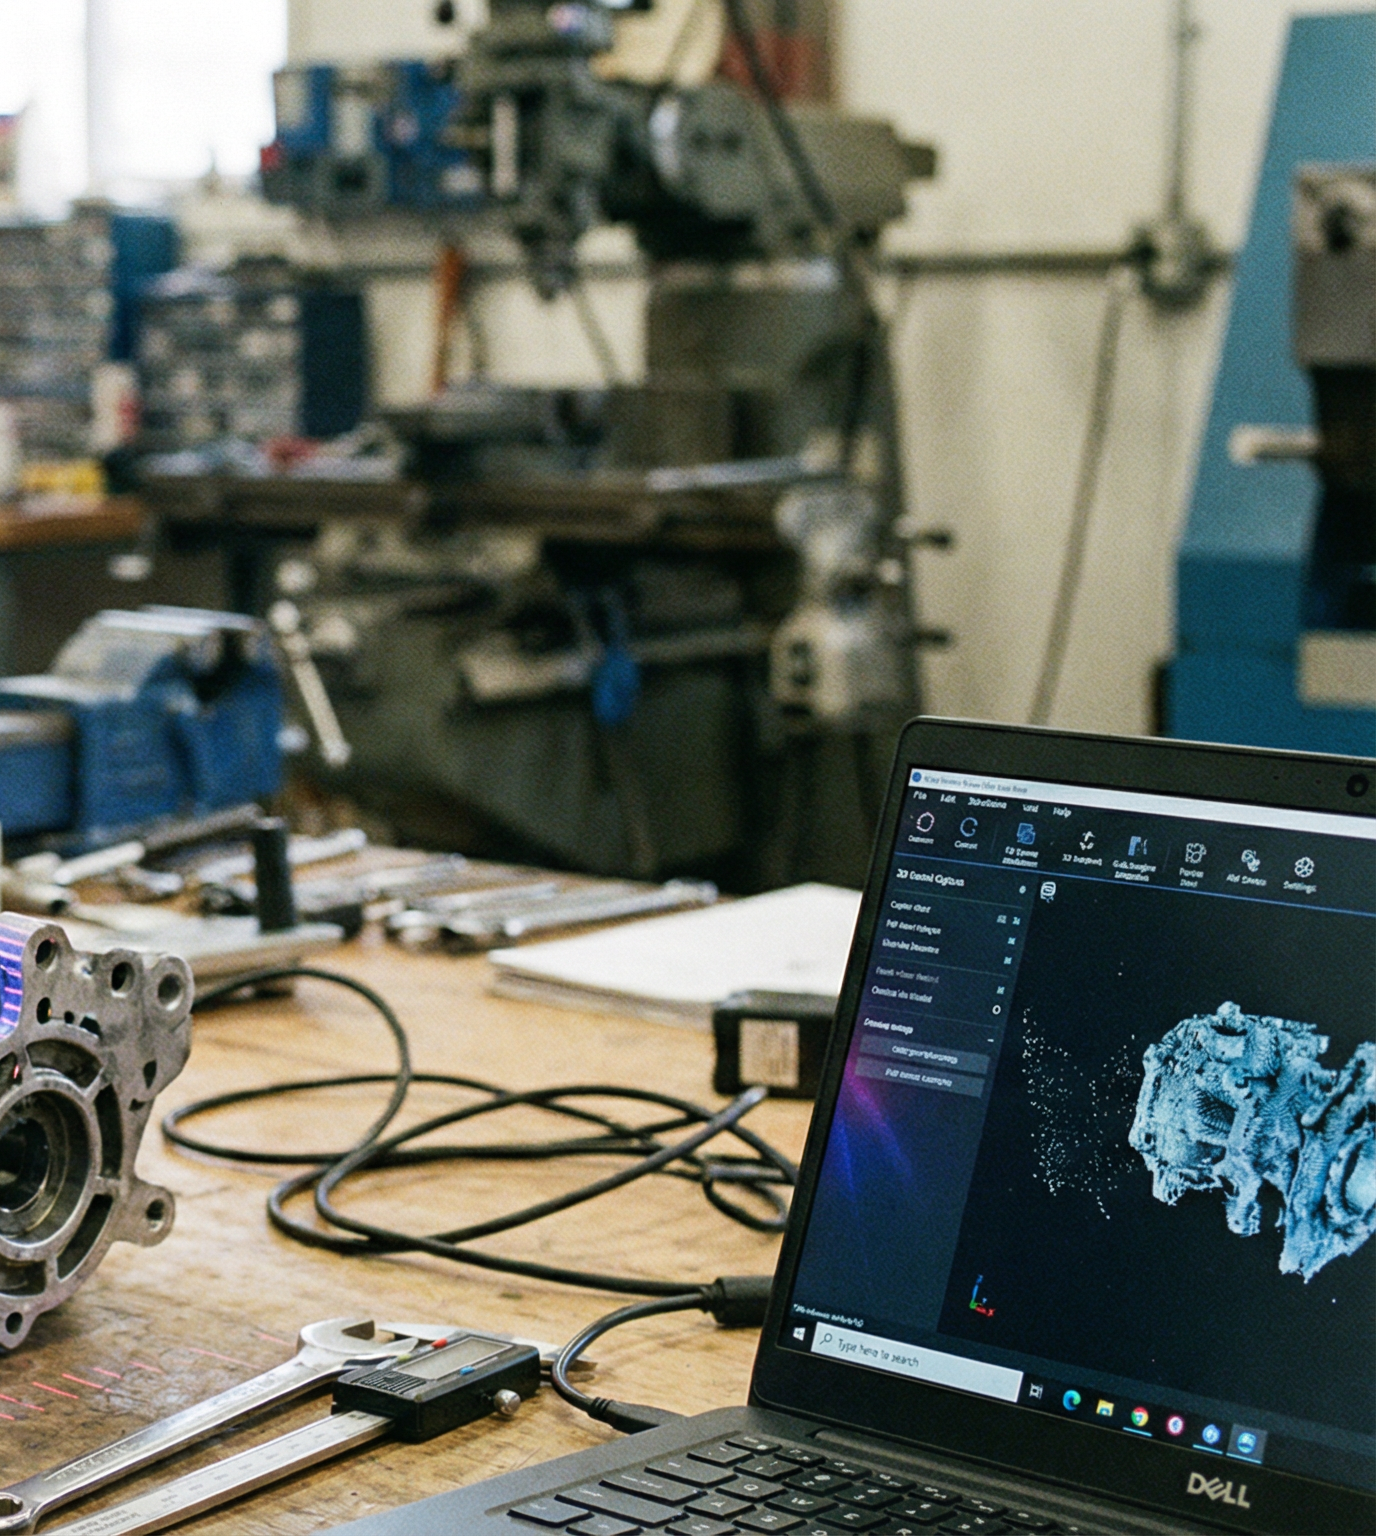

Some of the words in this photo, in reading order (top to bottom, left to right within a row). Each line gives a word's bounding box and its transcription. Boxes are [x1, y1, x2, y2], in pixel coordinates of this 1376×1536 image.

[838, 1338, 857, 1353] Type
[891, 1352, 920, 1368] search
[1187, 1472, 1251, 1509] DELL
